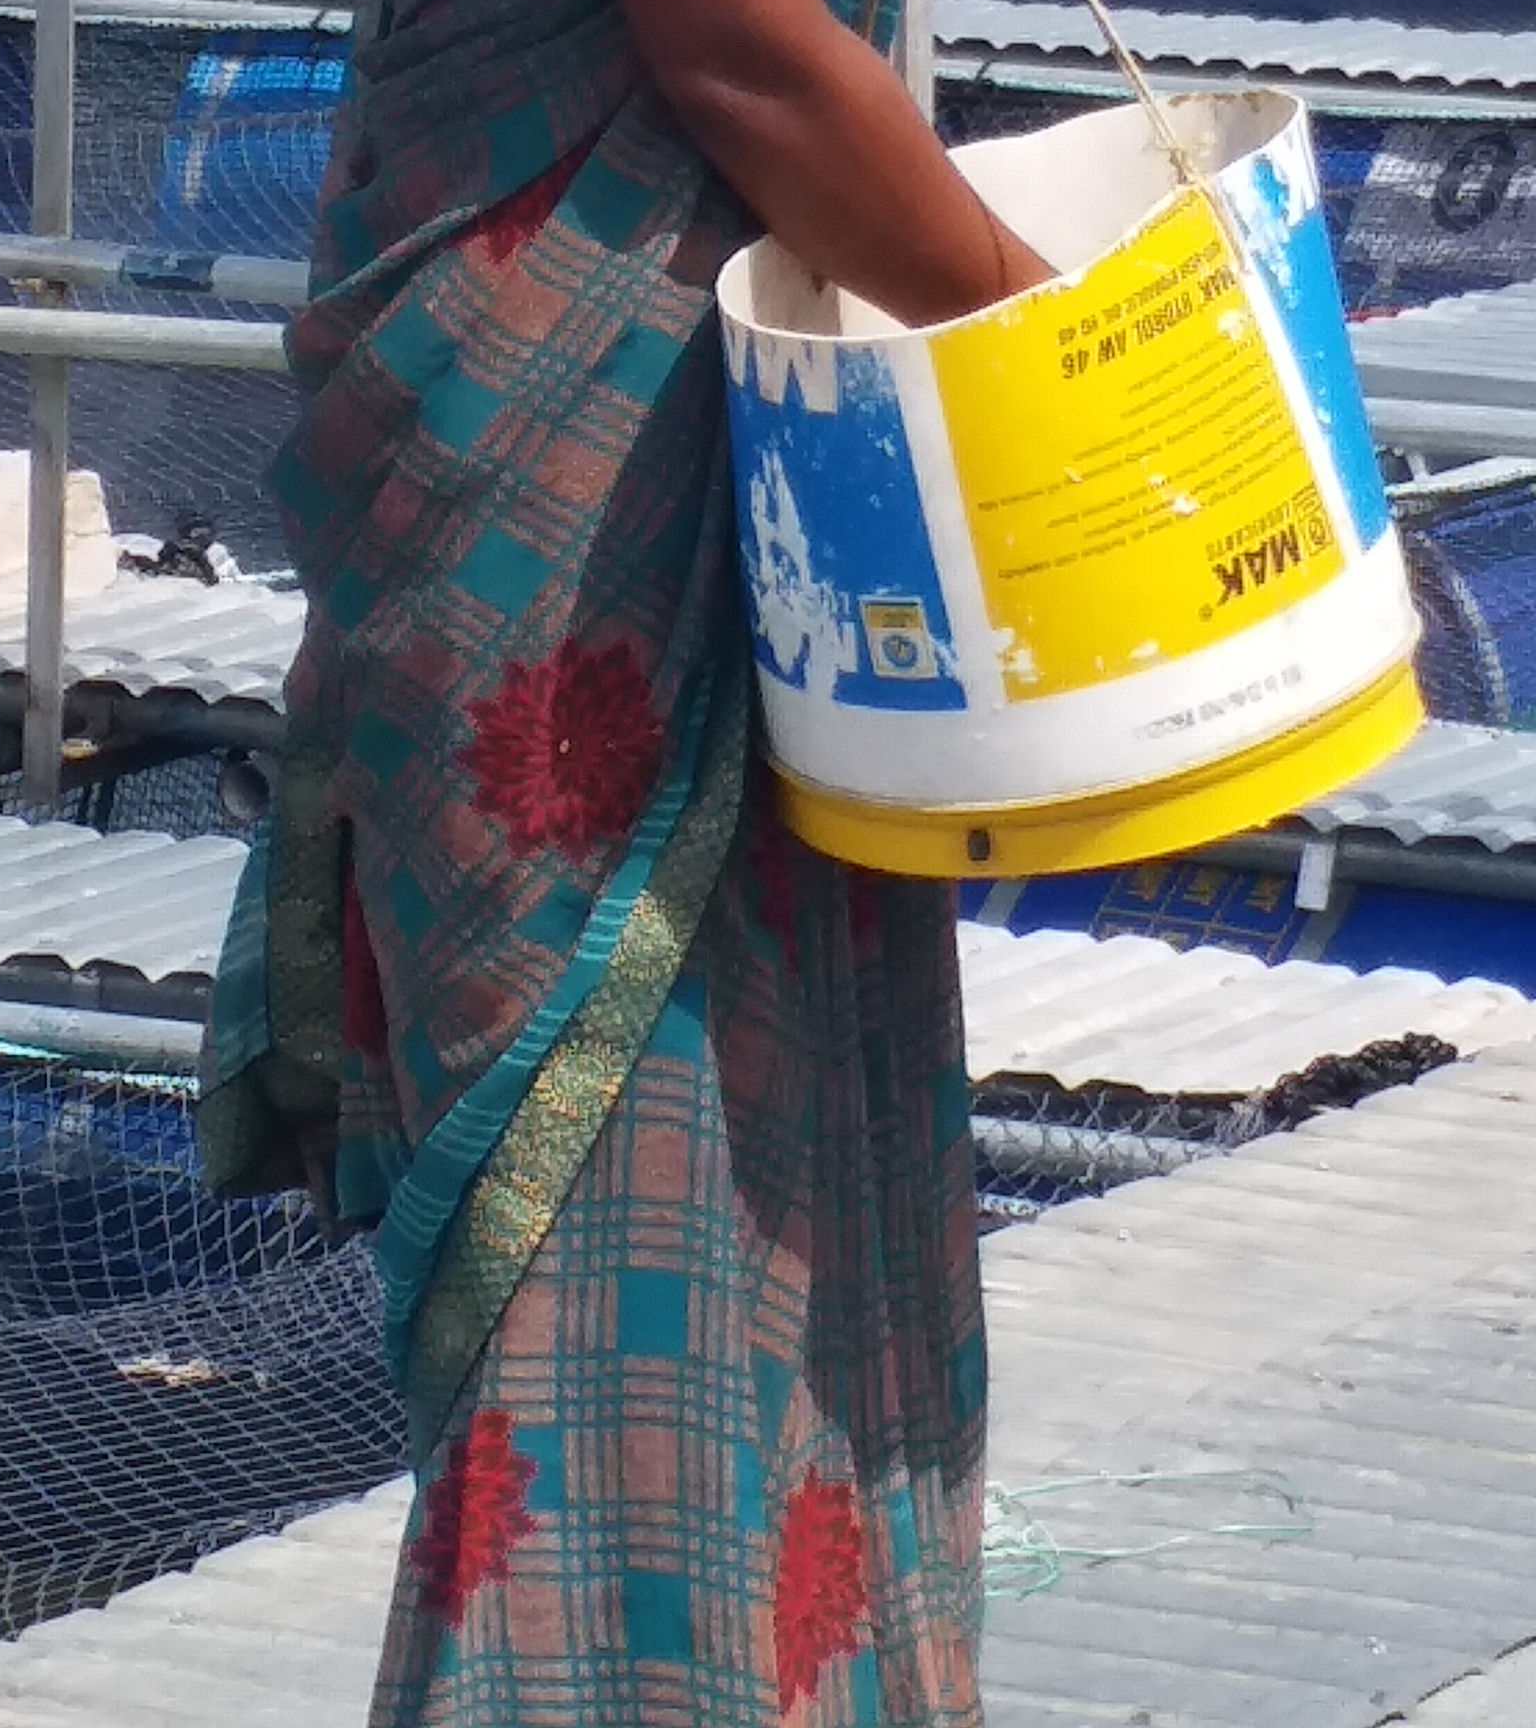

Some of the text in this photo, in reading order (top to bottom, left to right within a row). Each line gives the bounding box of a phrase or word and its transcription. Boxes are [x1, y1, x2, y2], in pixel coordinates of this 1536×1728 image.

[1062, 349, 1090, 379] 46
[1098, 328, 1127, 365] AW
[1213, 524, 1301, 604] MAK
